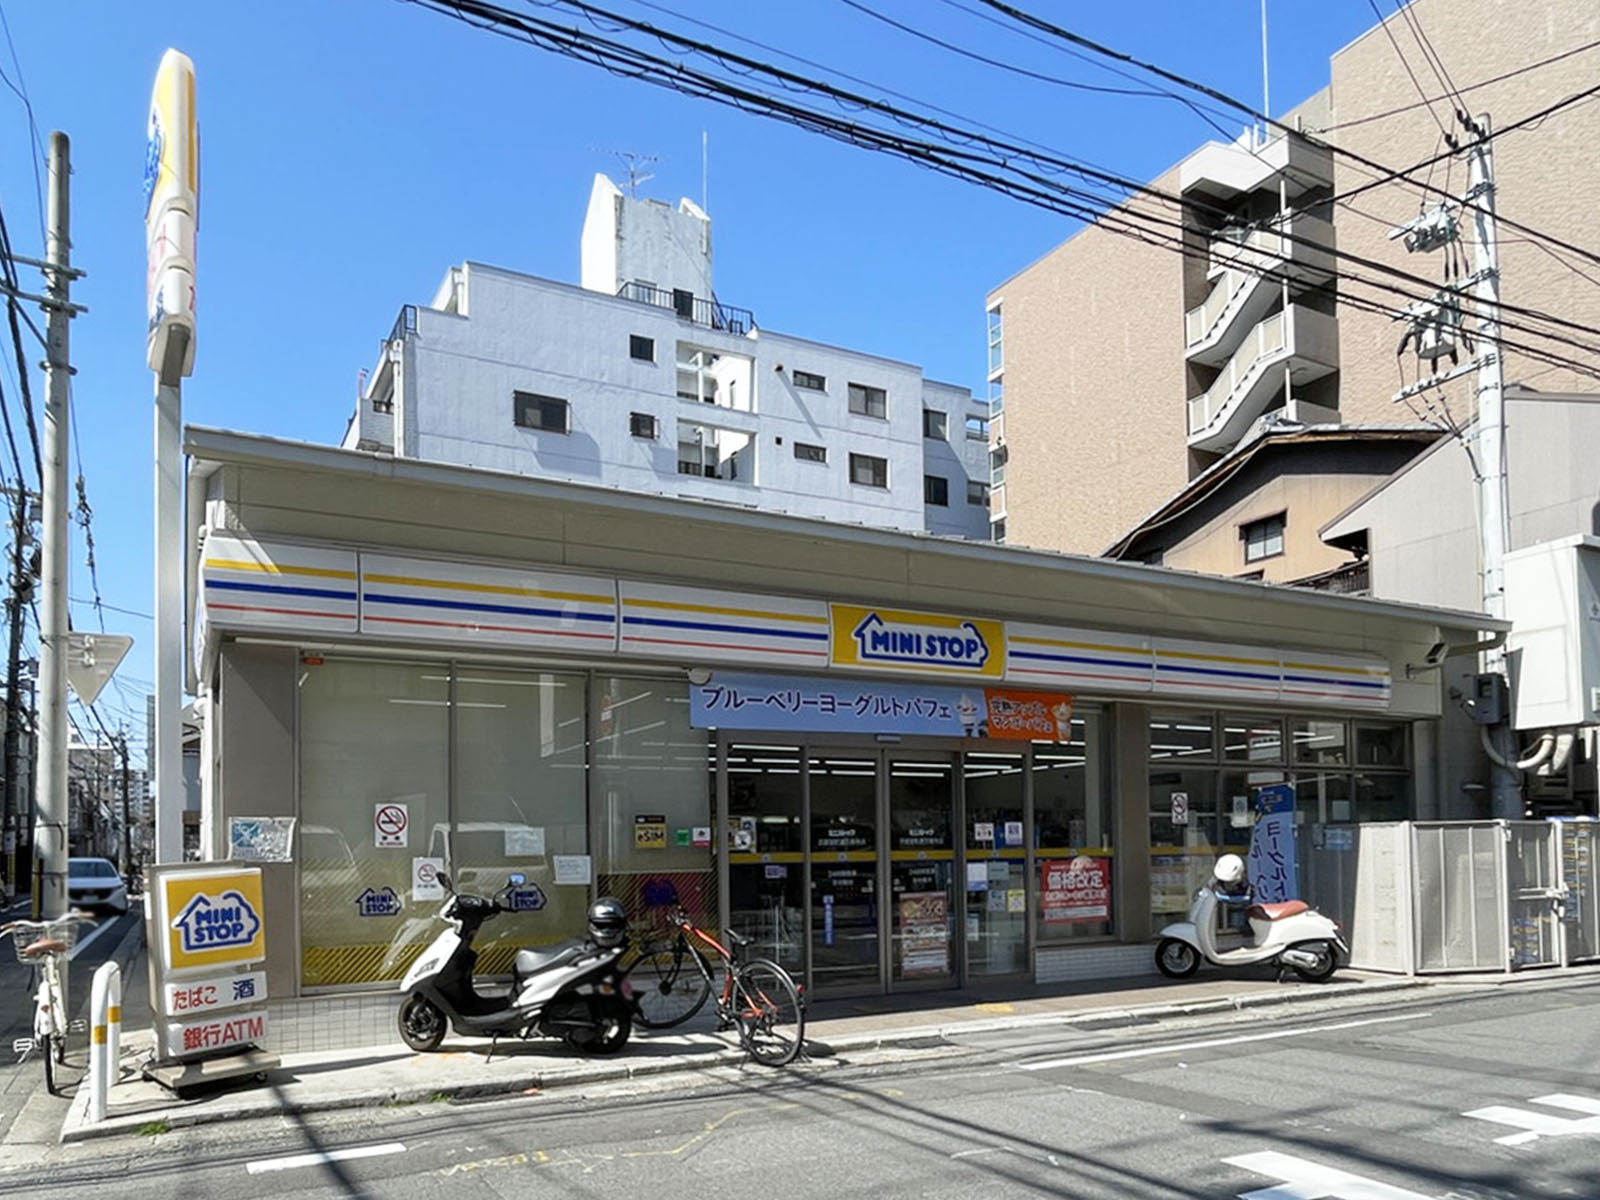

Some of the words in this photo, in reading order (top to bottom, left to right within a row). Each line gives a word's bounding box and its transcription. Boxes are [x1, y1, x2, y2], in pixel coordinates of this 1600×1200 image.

[871, 630, 921, 655] MINI
[925, 634, 979, 659] STOP
[702, 687, 952, 718] ブルーベリーヨーグルトパフェ
[195, 907, 241, 924] MINI
[194, 923, 244, 943] STOP
[173, 985, 218, 1011] たばこ
[233, 978, 255, 1001] 酒
[183, 1016, 264, 1051] 銀行ATM
